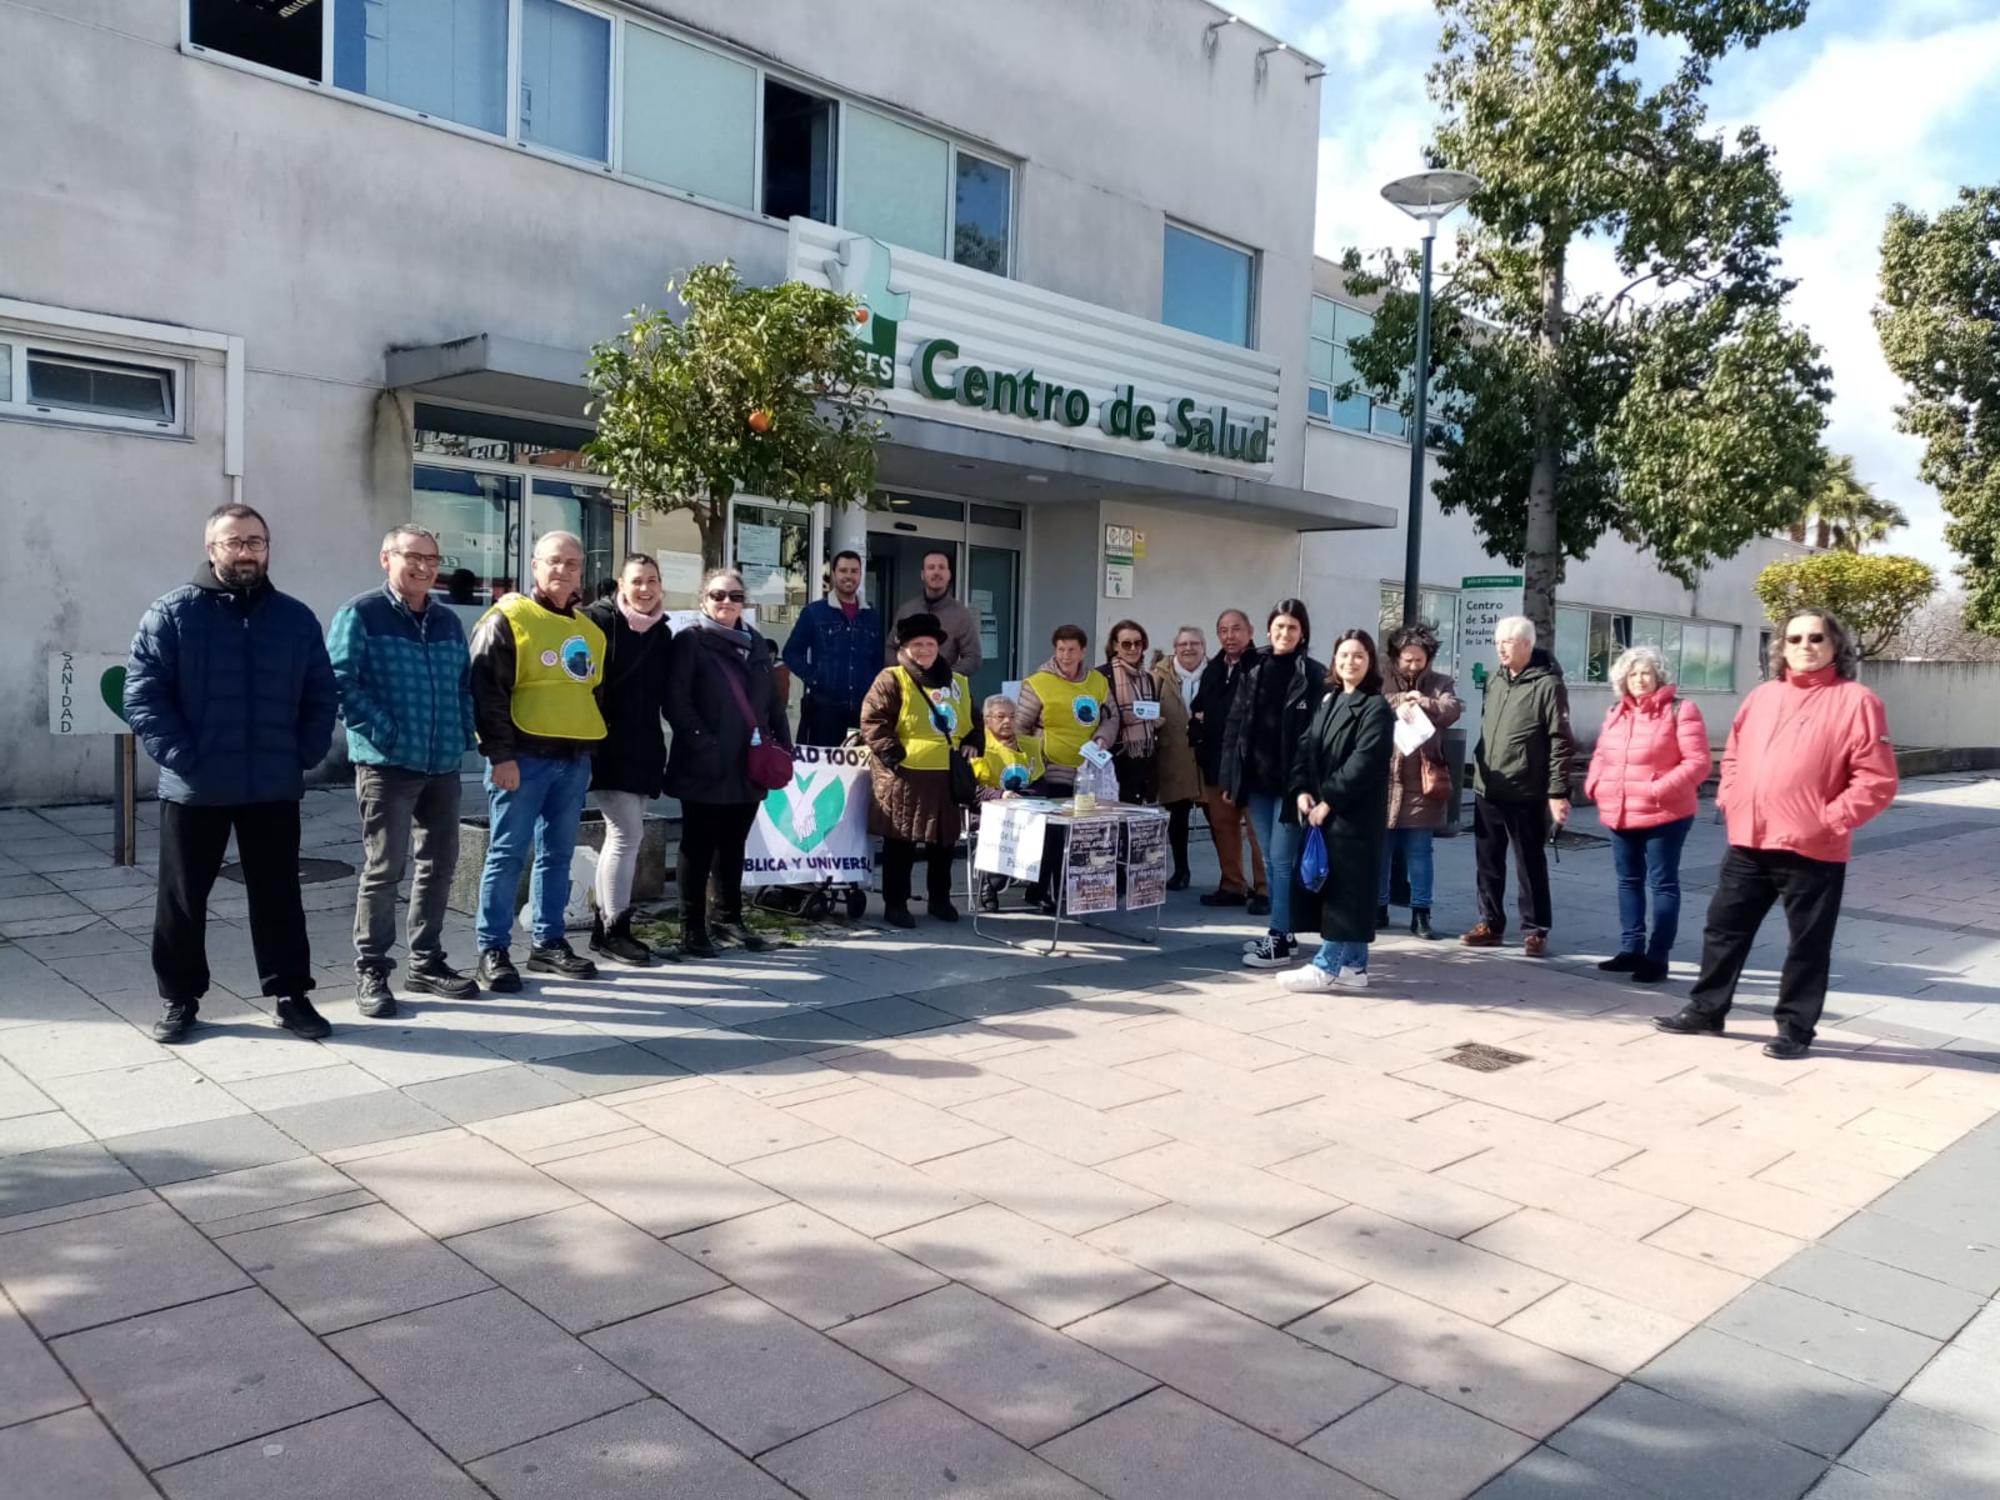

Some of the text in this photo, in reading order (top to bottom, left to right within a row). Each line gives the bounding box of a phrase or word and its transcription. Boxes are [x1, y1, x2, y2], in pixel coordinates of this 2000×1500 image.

[912, 338, 1269, 463] Centro de Salud
[1466, 600, 1504, 611] Centro
[1465, 614, 1477, 625] de
[61, 651, 73, 733] SANIDAD
[825, 748, 870, 768] 100%
[791, 858, 802, 868] Y
